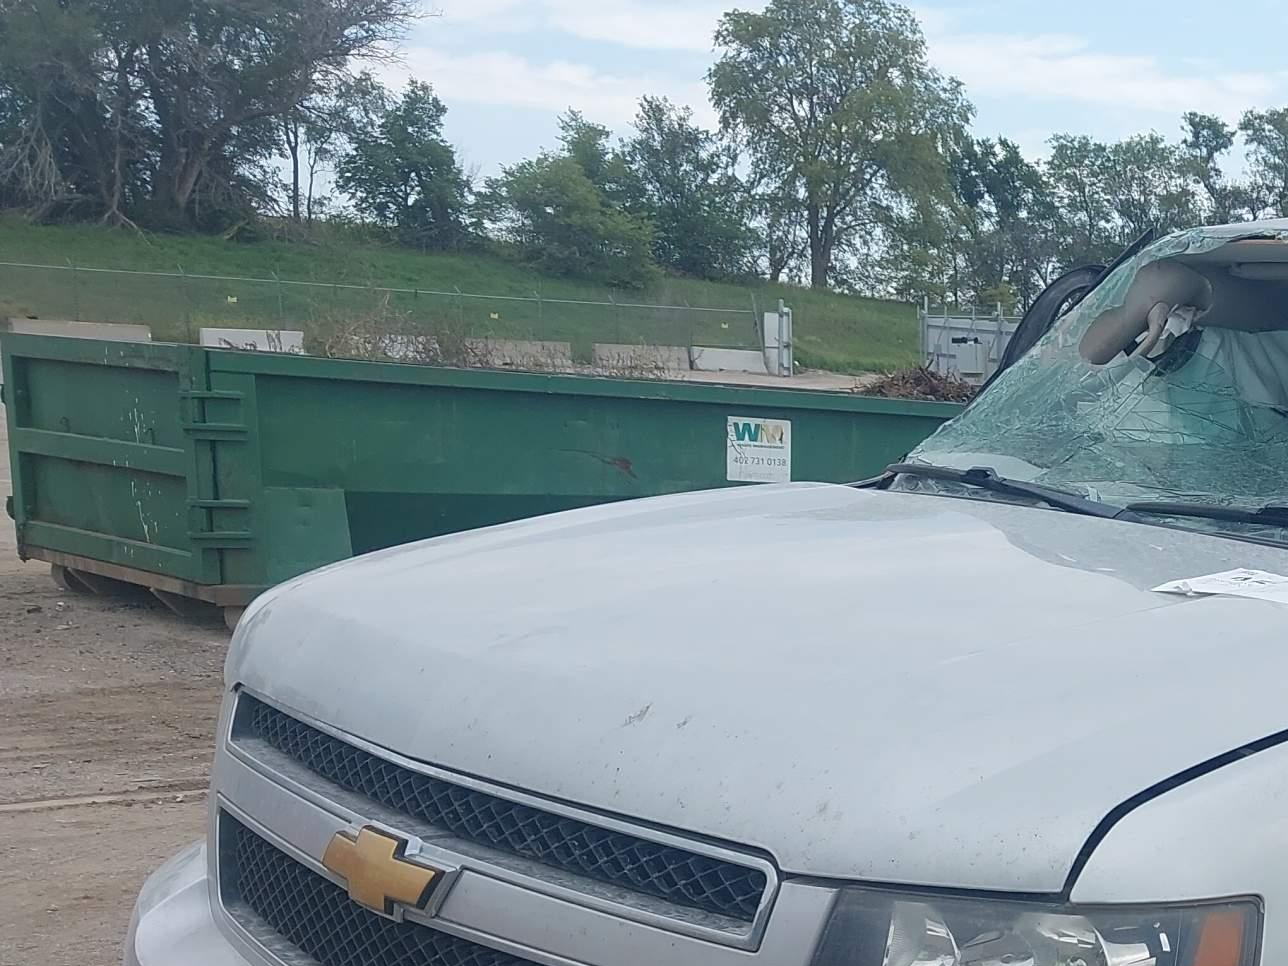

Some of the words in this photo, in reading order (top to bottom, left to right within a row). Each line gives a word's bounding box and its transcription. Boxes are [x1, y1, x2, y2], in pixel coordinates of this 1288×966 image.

[733, 455, 749, 465] 402
[750, 456, 765, 465] 731
[766, 457, 787, 467] 0138
